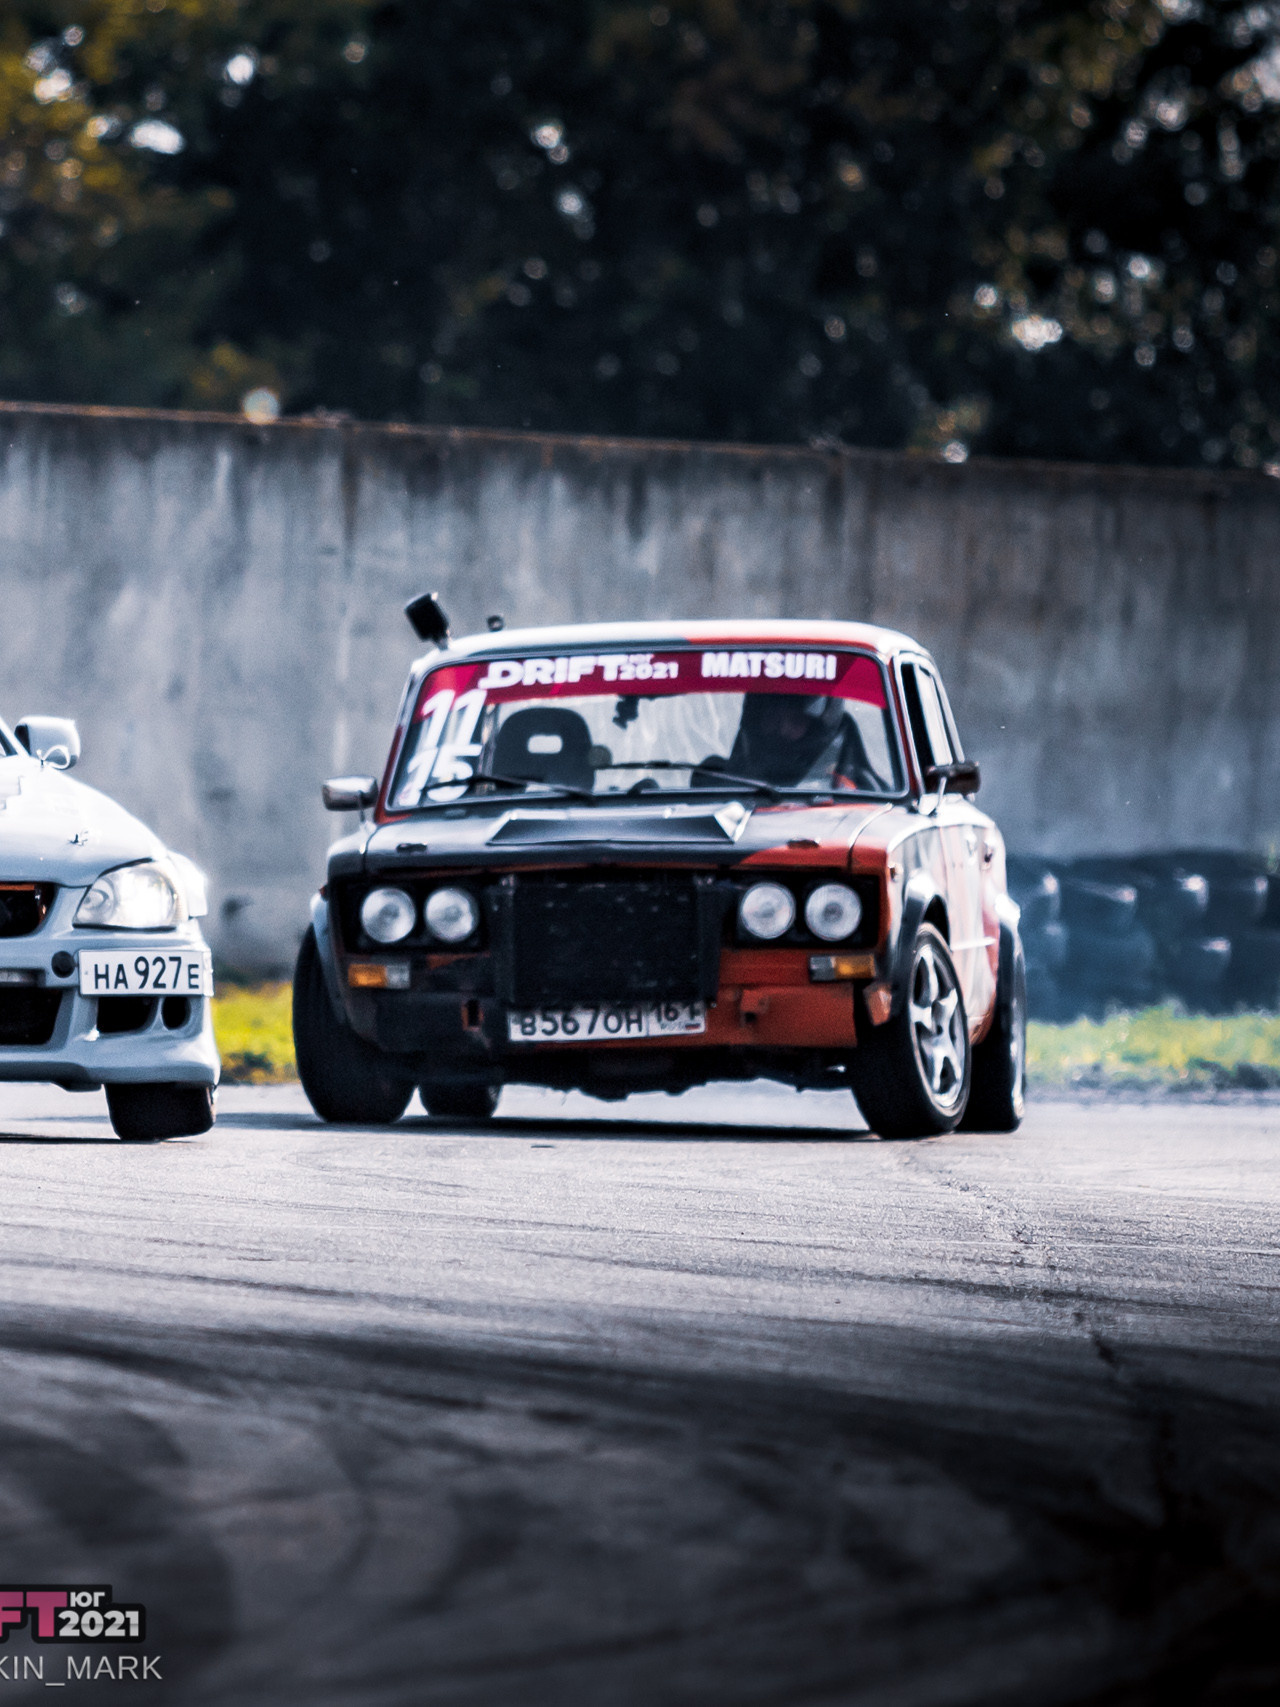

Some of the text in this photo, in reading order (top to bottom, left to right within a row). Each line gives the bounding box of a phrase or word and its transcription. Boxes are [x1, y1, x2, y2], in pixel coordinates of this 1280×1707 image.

[478, 654, 629, 690] DRIFT
[618, 662, 679, 680] 2021
[701, 652, 837, 680] MATSURI
[398, 744, 483, 806] 15
